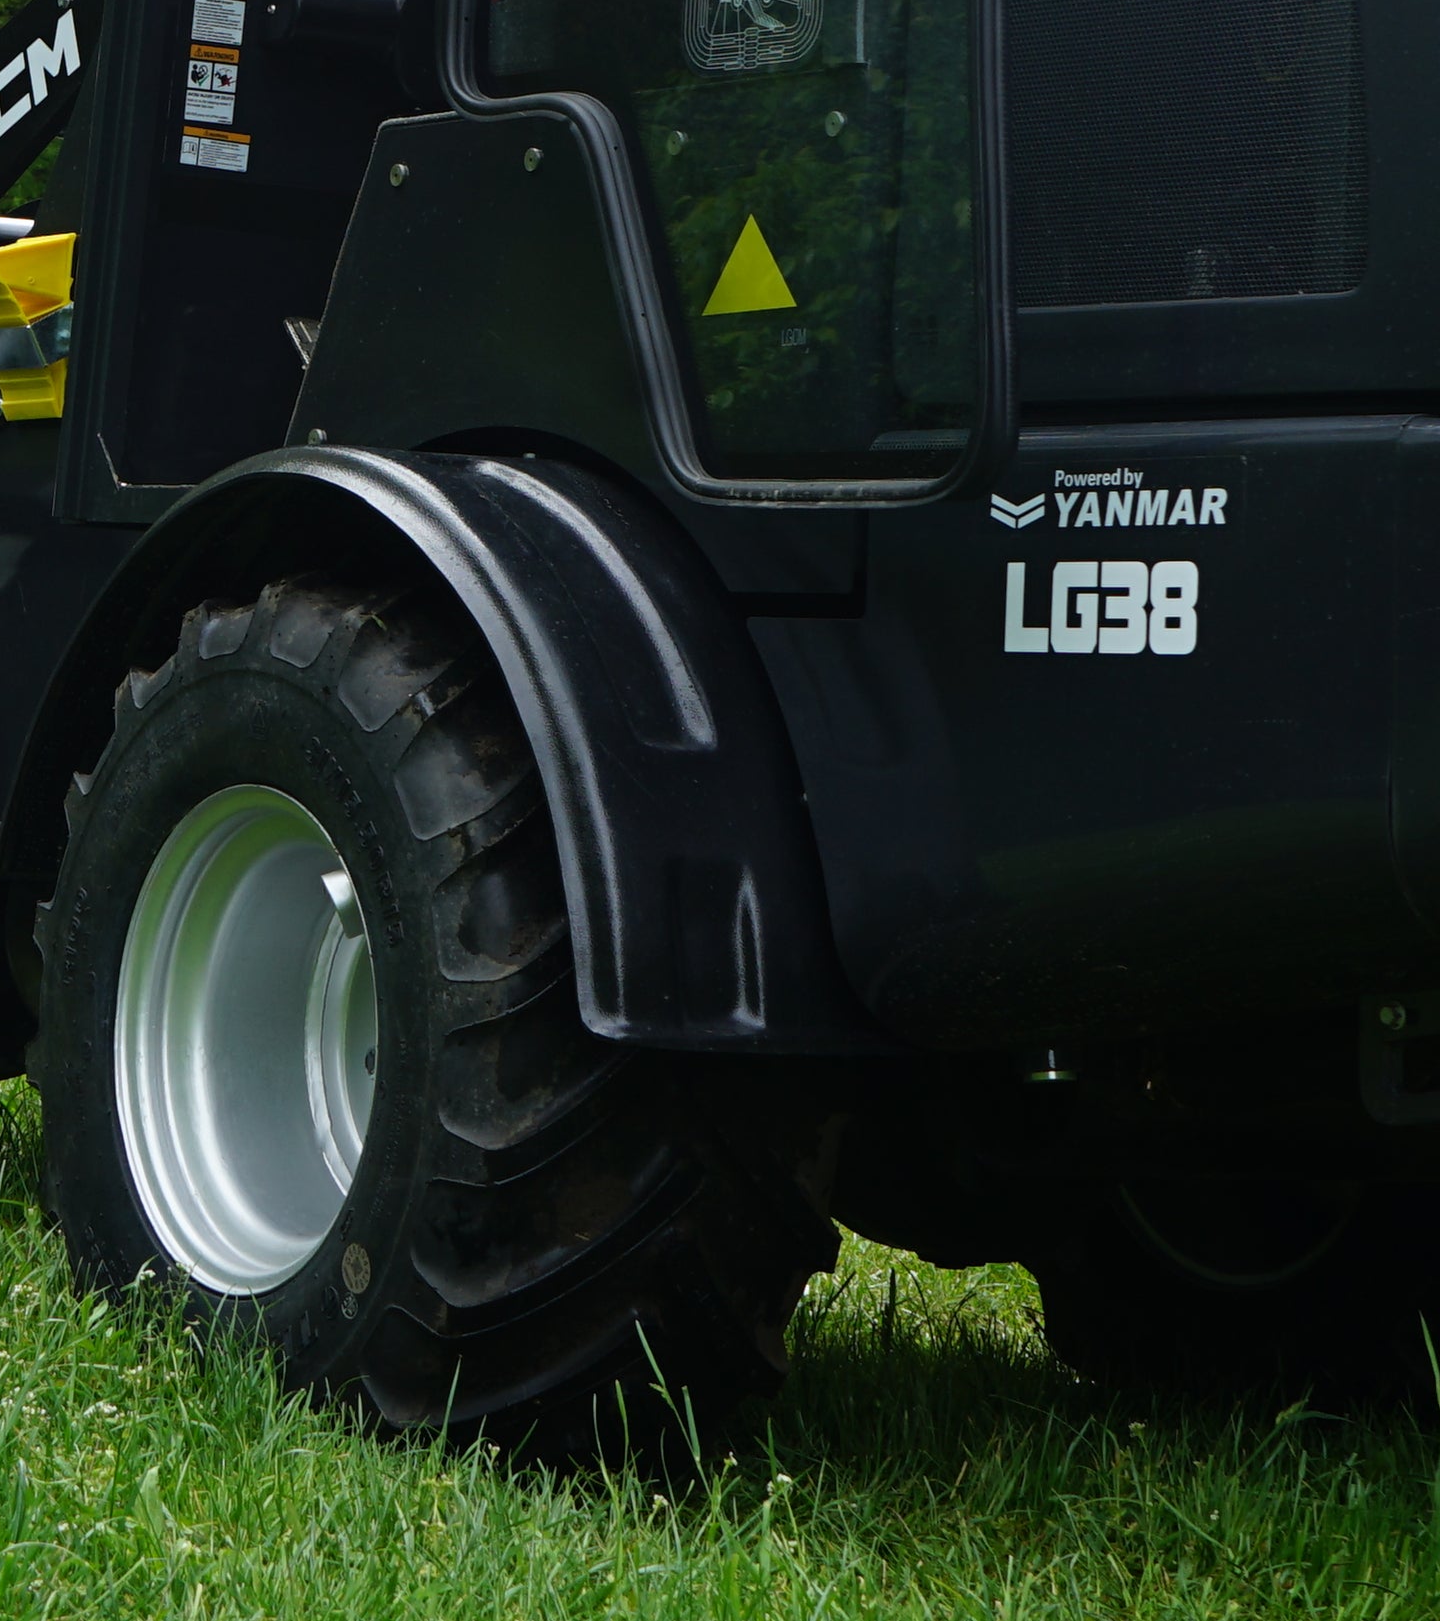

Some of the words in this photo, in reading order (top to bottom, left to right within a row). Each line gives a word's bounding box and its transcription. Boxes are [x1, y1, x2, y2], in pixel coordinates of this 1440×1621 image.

[1054, 468, 1121, 487] Powered
[1123, 468, 1144, 488] by
[1054, 488, 1228, 528] YANMAR
[1004, 560, 1199, 655] LG38
